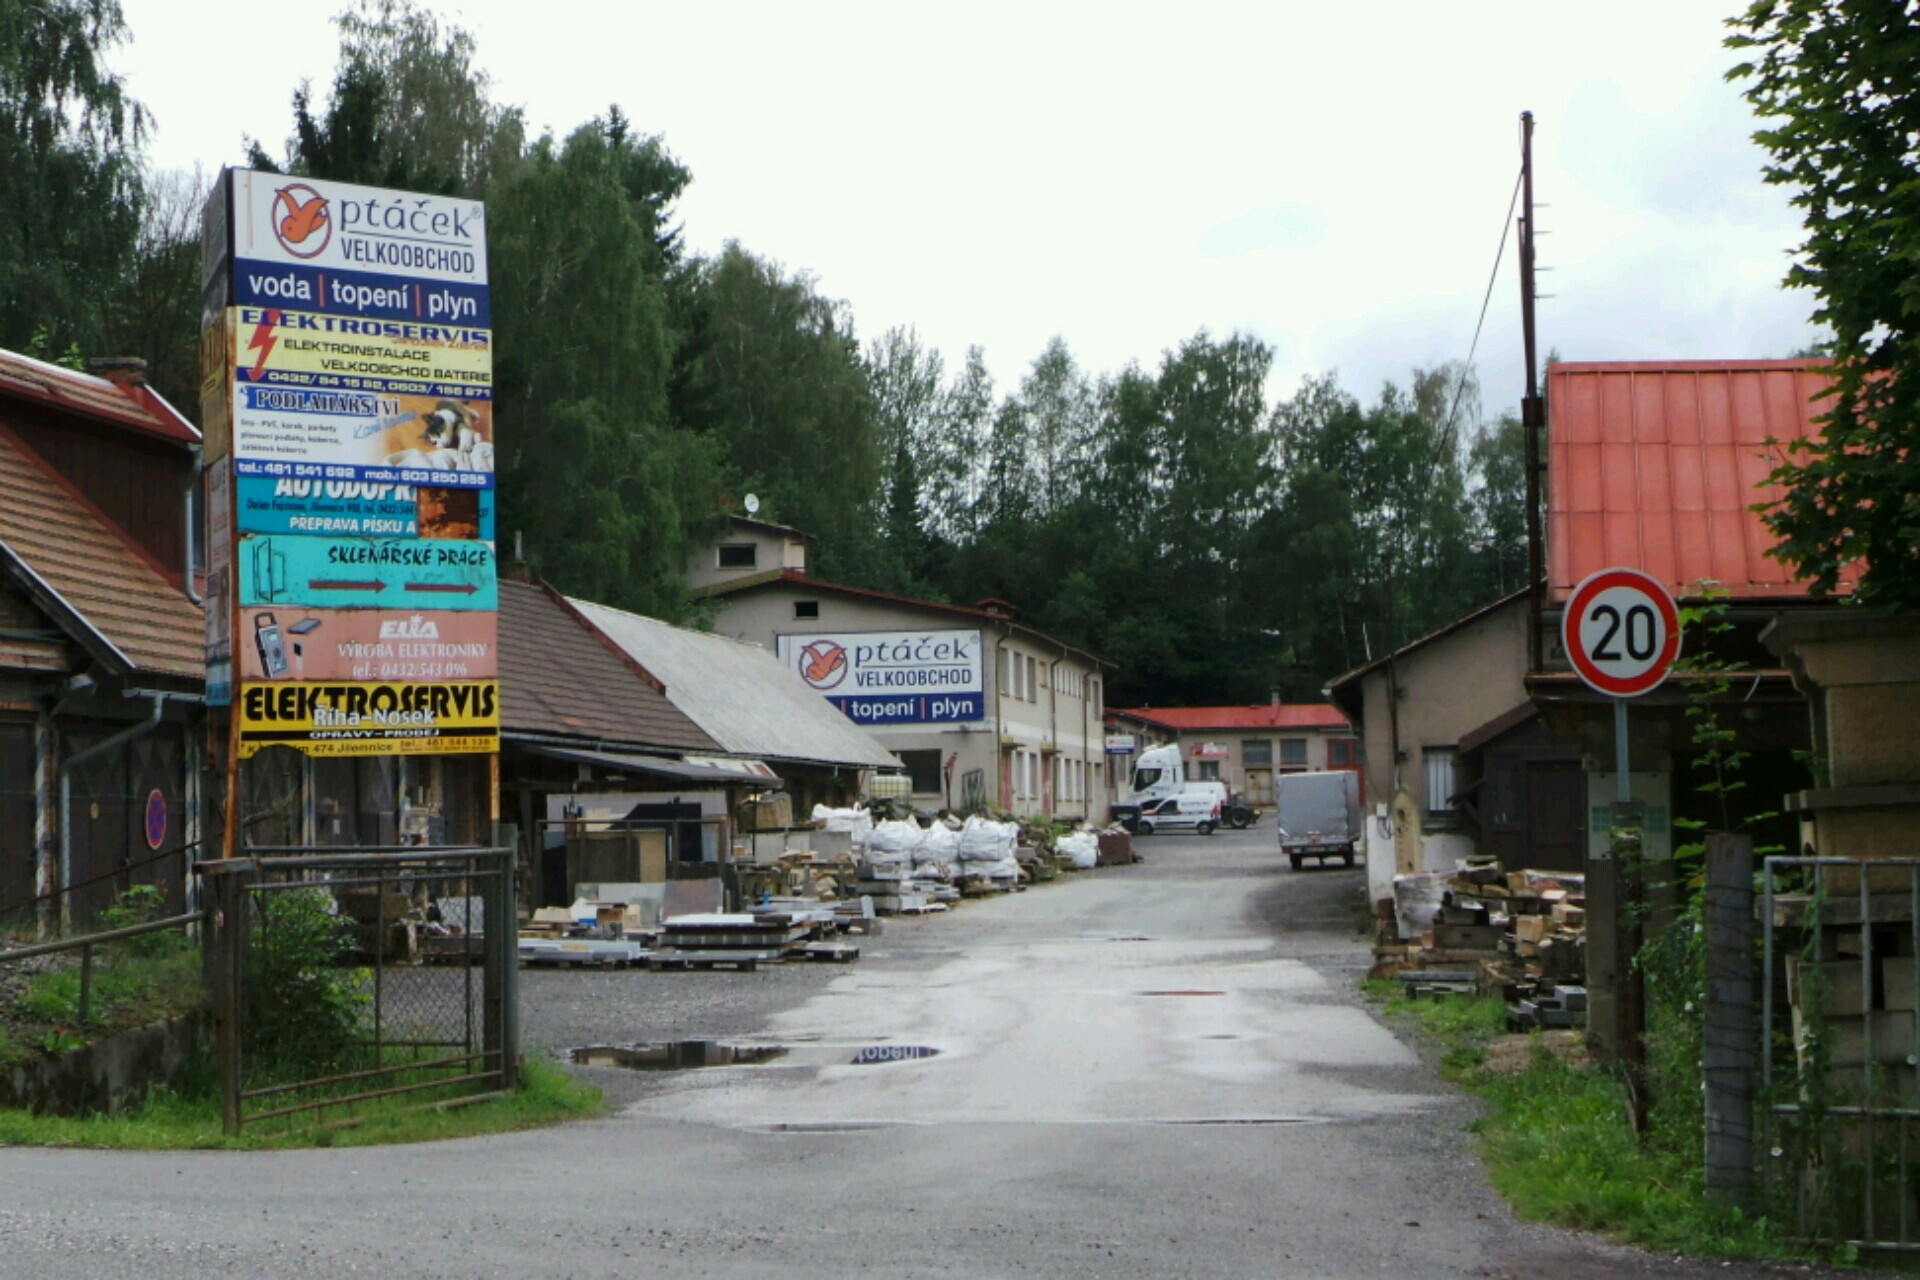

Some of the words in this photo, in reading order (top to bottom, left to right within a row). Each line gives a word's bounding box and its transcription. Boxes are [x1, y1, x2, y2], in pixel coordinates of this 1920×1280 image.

[340, 198, 471, 238] ptáček
[341, 238, 475, 273] VELKOOBCHOD
[249, 273, 312, 301] voda
[332, 279, 409, 310] topení
[428, 290, 477, 320] plyn
[241, 309, 489, 344] ELEKTROSERVIS
[284, 339, 431, 361] ELEKTROINSTALACE
[320, 359, 430, 378] VELKOOBCHOD
[434, 368, 490, 382] BATERIE
[264, 463, 291, 475] 481
[296, 464, 322, 477] 541
[290, 514, 358, 533] PŘEPRAVA
[363, 515, 400, 533] PÍSKU
[406, 519, 416, 533] A
[437, 545, 487, 566] PRÁCE
[1590, 604, 1656, 661] 20
[337, 641, 394, 659] VÝROBA
[398, 643, 487, 659] ELEKTRONIKY
[855, 636, 969, 668] ptáček
[856, 669, 972, 688] VELKOOBCHOD
[244, 685, 496, 721] ELEKTROSERVIS
[851, 698, 915, 720] topení
[931, 697, 973, 717] plyn
